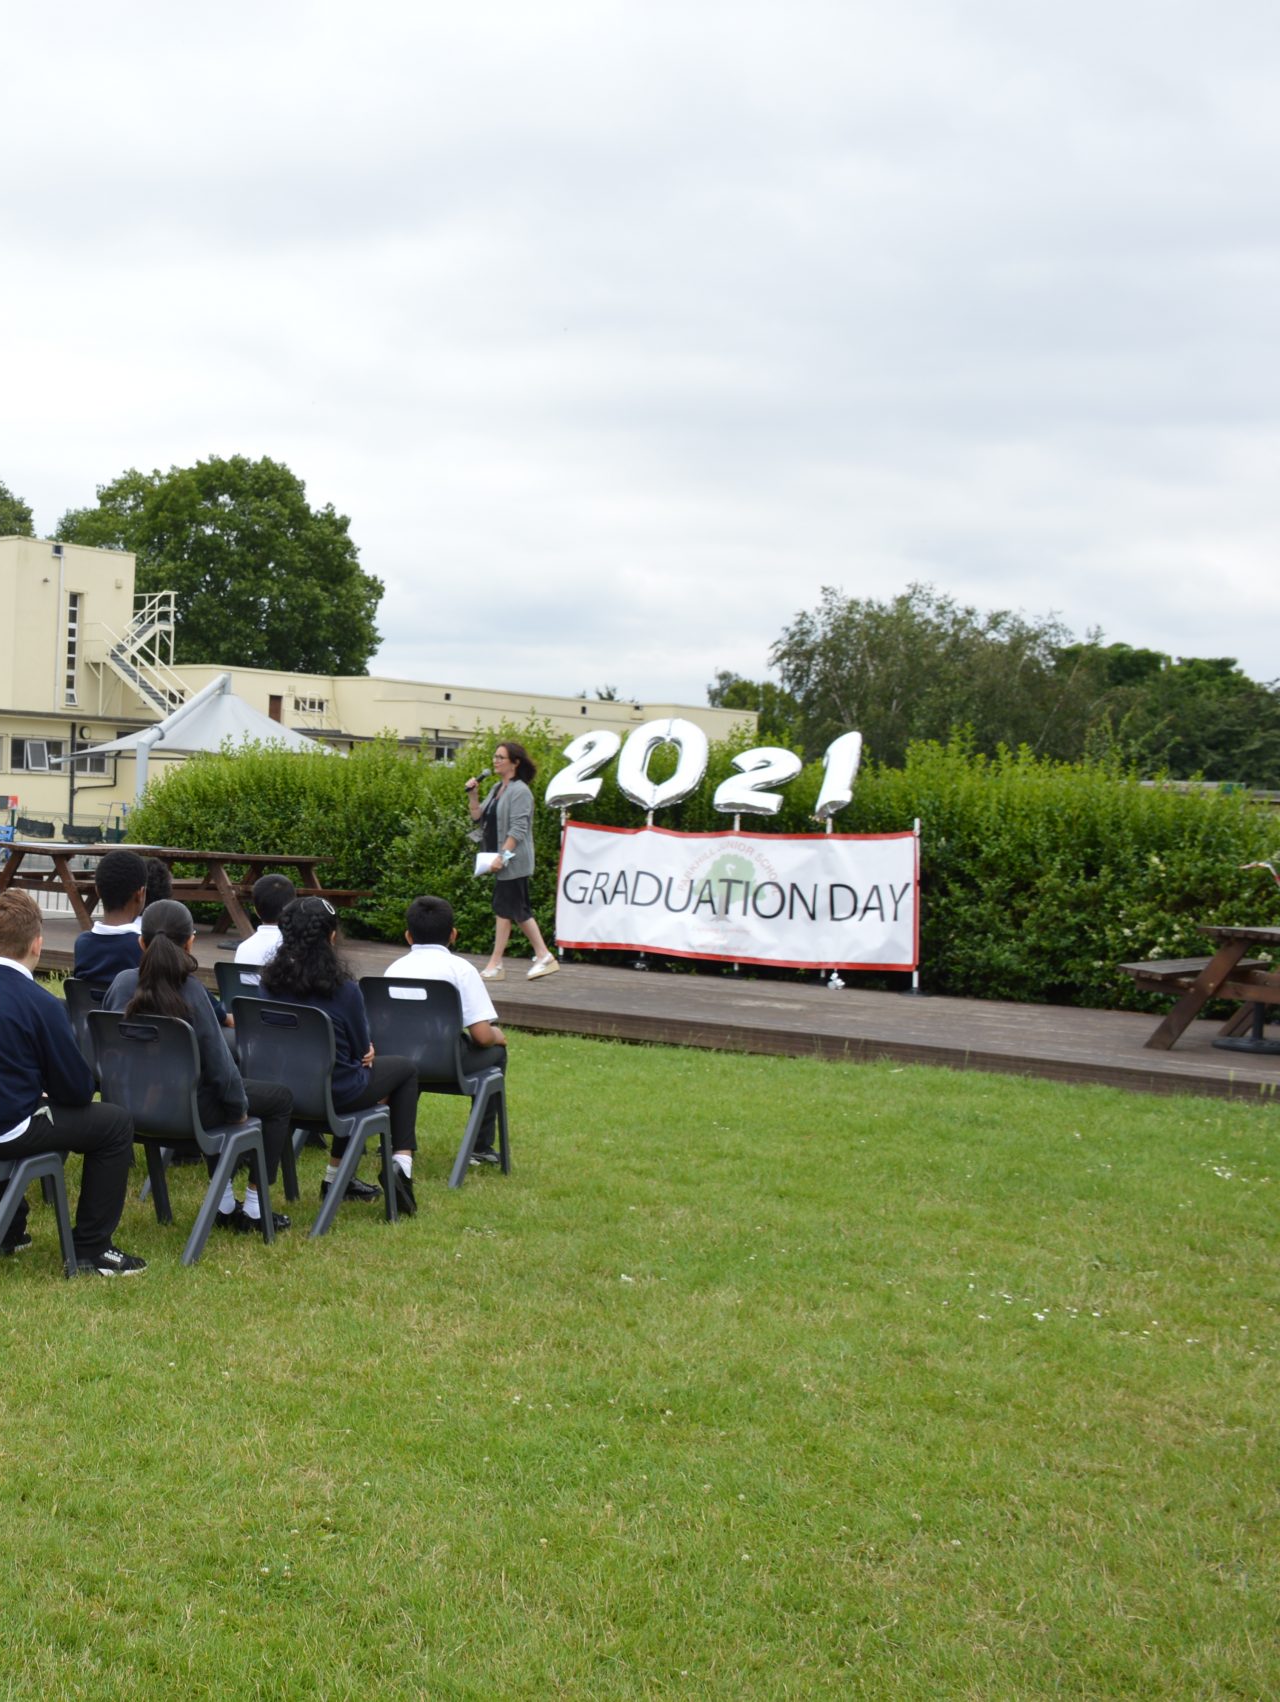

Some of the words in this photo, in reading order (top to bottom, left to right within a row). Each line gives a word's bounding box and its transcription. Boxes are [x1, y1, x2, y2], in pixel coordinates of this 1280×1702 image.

[545, 718, 862, 821] 2021
[562, 869, 818, 922] GRADUATION
[829, 882, 912, 922] DAY
